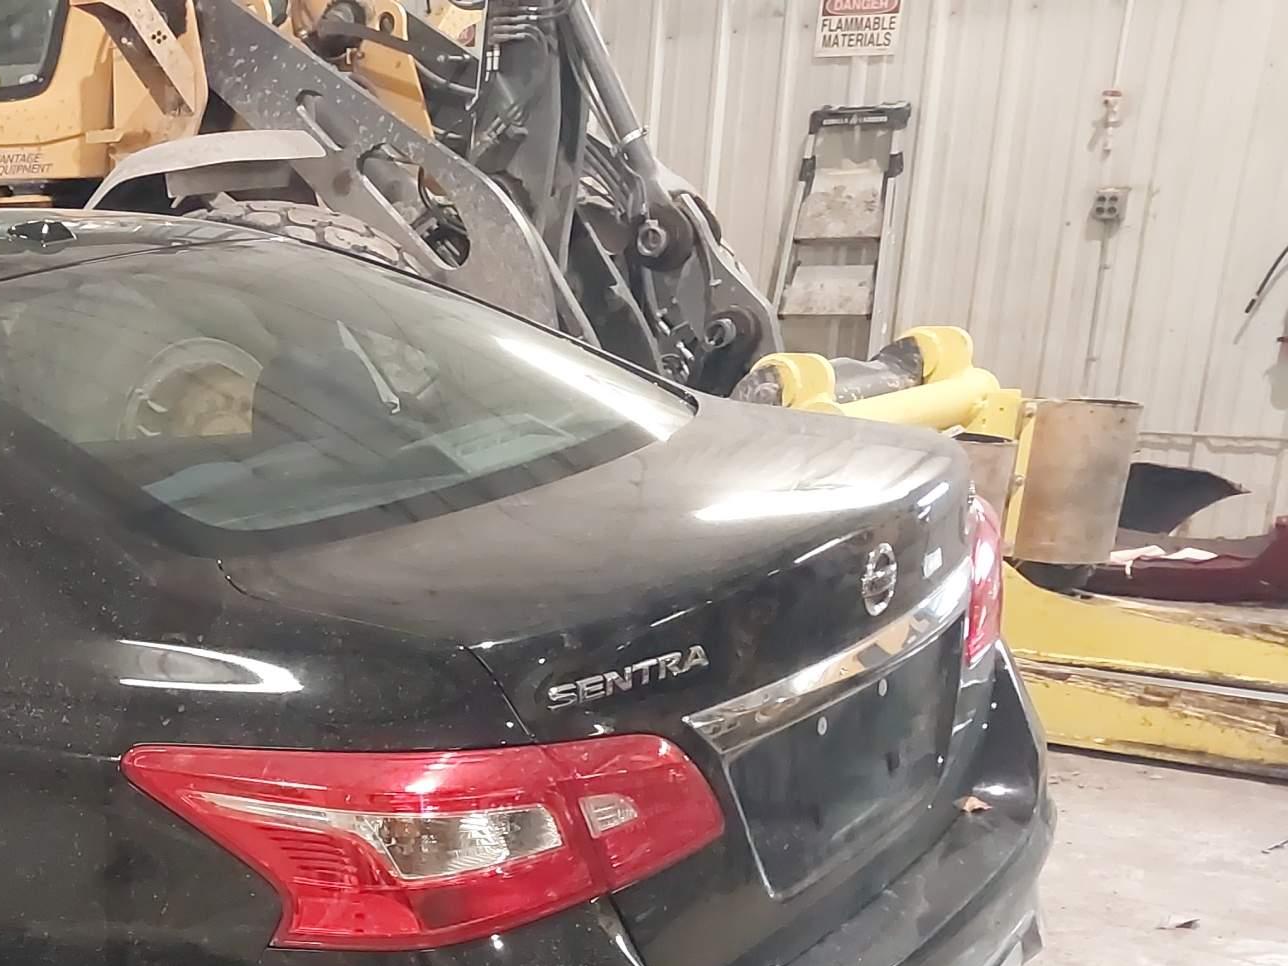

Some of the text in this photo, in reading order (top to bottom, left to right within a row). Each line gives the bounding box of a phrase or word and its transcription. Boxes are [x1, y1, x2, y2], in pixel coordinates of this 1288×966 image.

[821, 16, 896, 32] FLAMMABLE
[822, 32, 892, 48] MATERIALS
[547, 645, 710, 709] SENTRA
